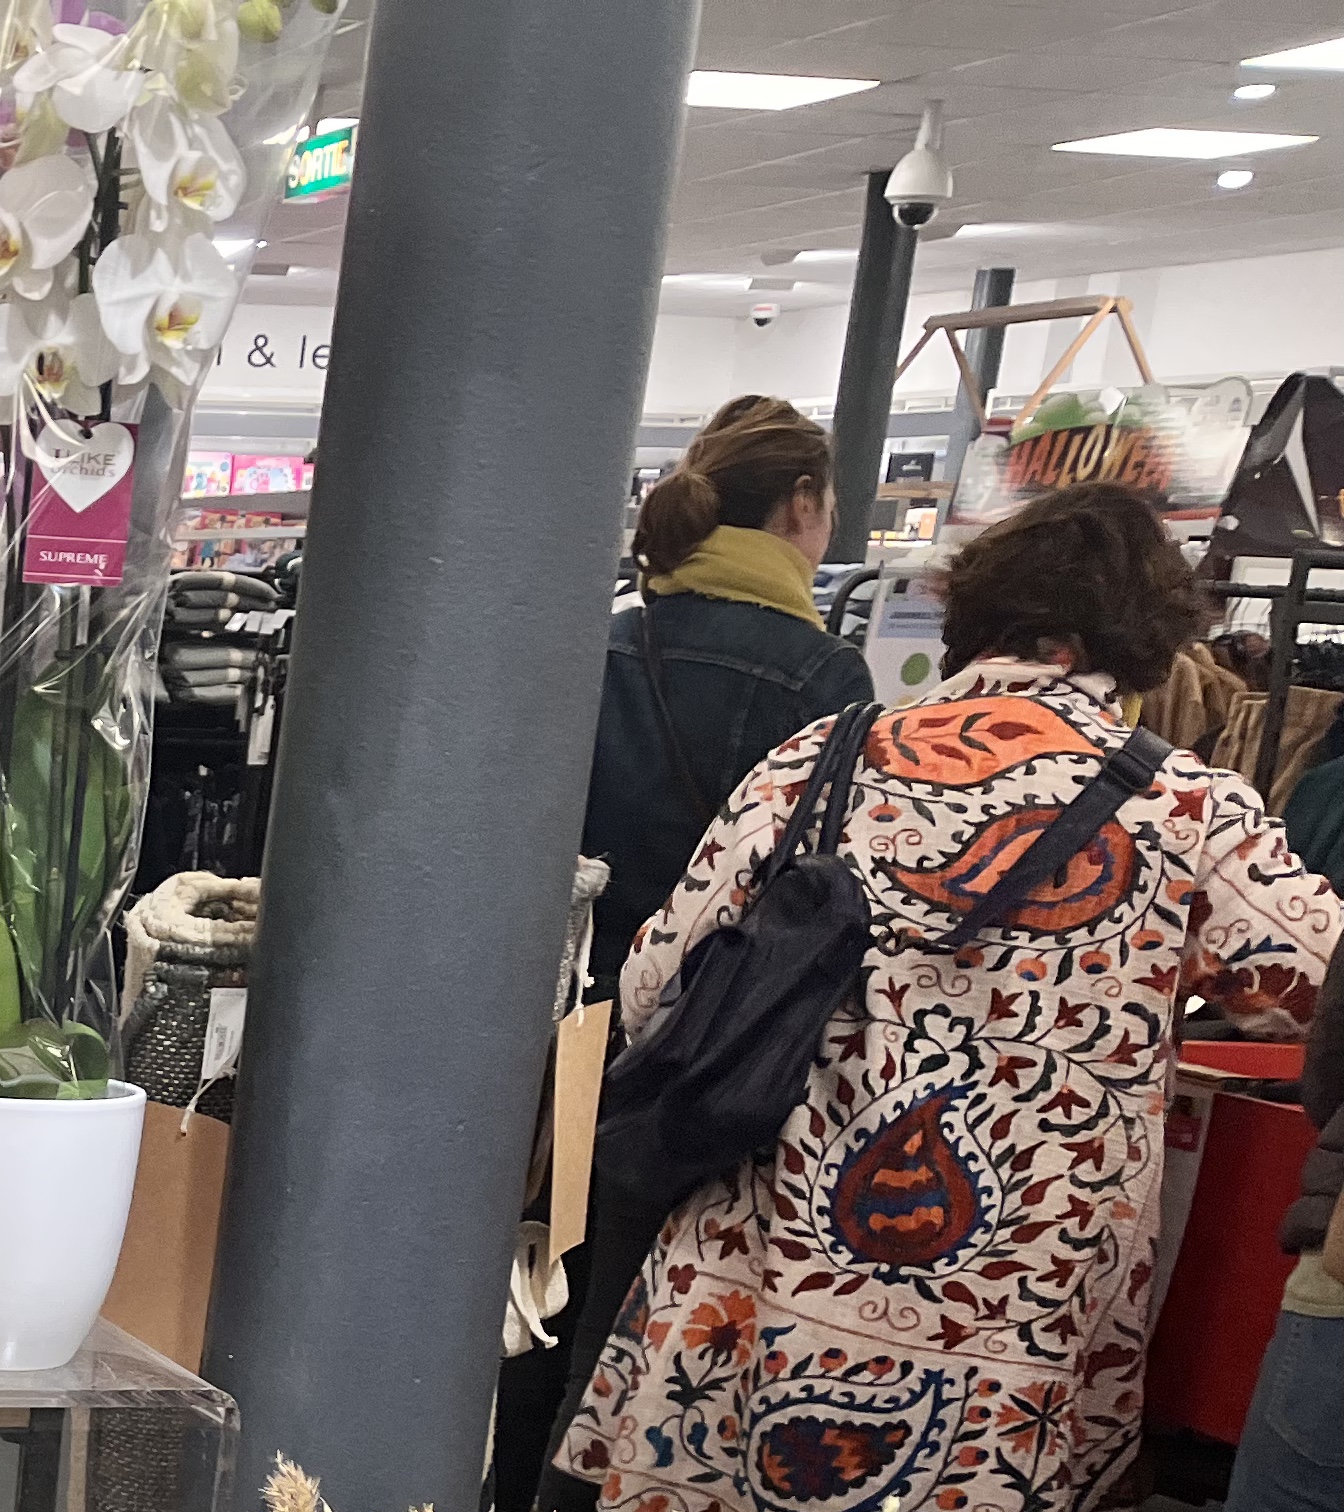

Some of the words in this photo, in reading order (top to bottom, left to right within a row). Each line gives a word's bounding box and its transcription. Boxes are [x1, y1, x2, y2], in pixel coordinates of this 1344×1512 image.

[288, 139, 349, 188] SORTIE
[247, 333, 276, 369] &
[39, 550, 108, 565] SUPREME
